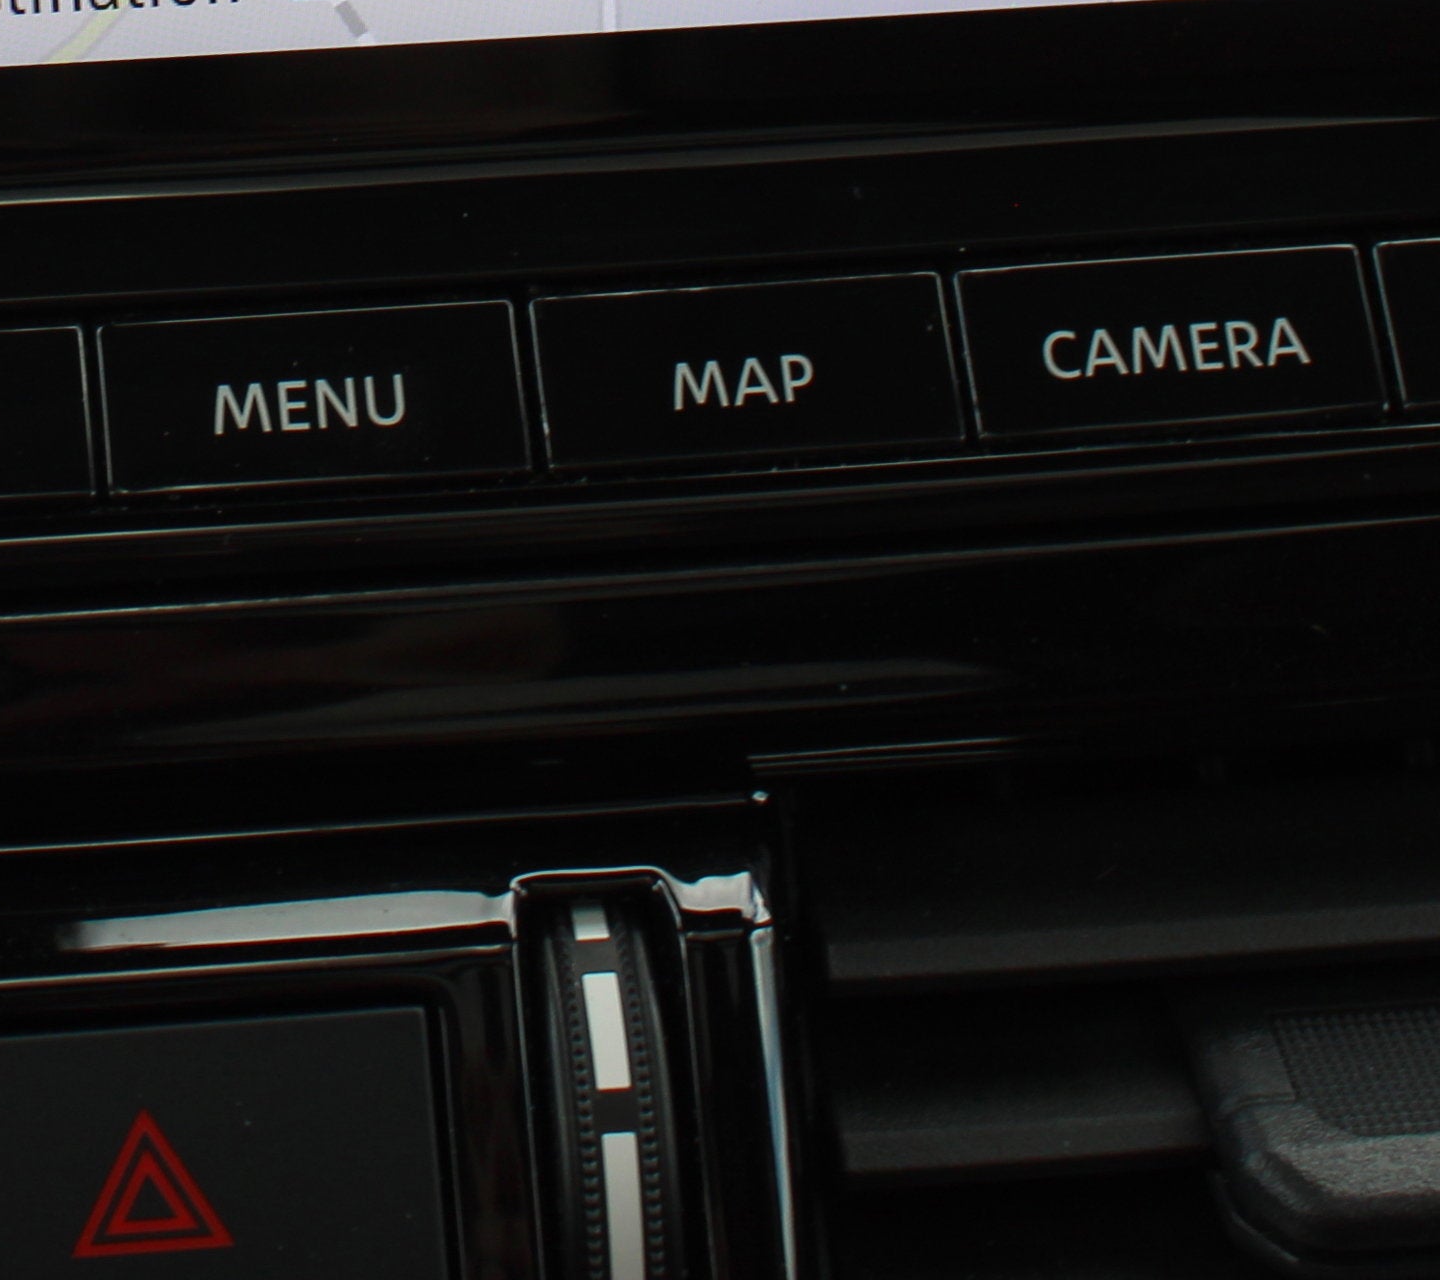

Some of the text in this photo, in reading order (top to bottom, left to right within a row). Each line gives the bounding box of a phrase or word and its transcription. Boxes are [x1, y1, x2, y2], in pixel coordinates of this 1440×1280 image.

[1042, 317, 1312, 381] CAMERA
[213, 374, 407, 436] MENU
[673, 352, 815, 412] MAP
